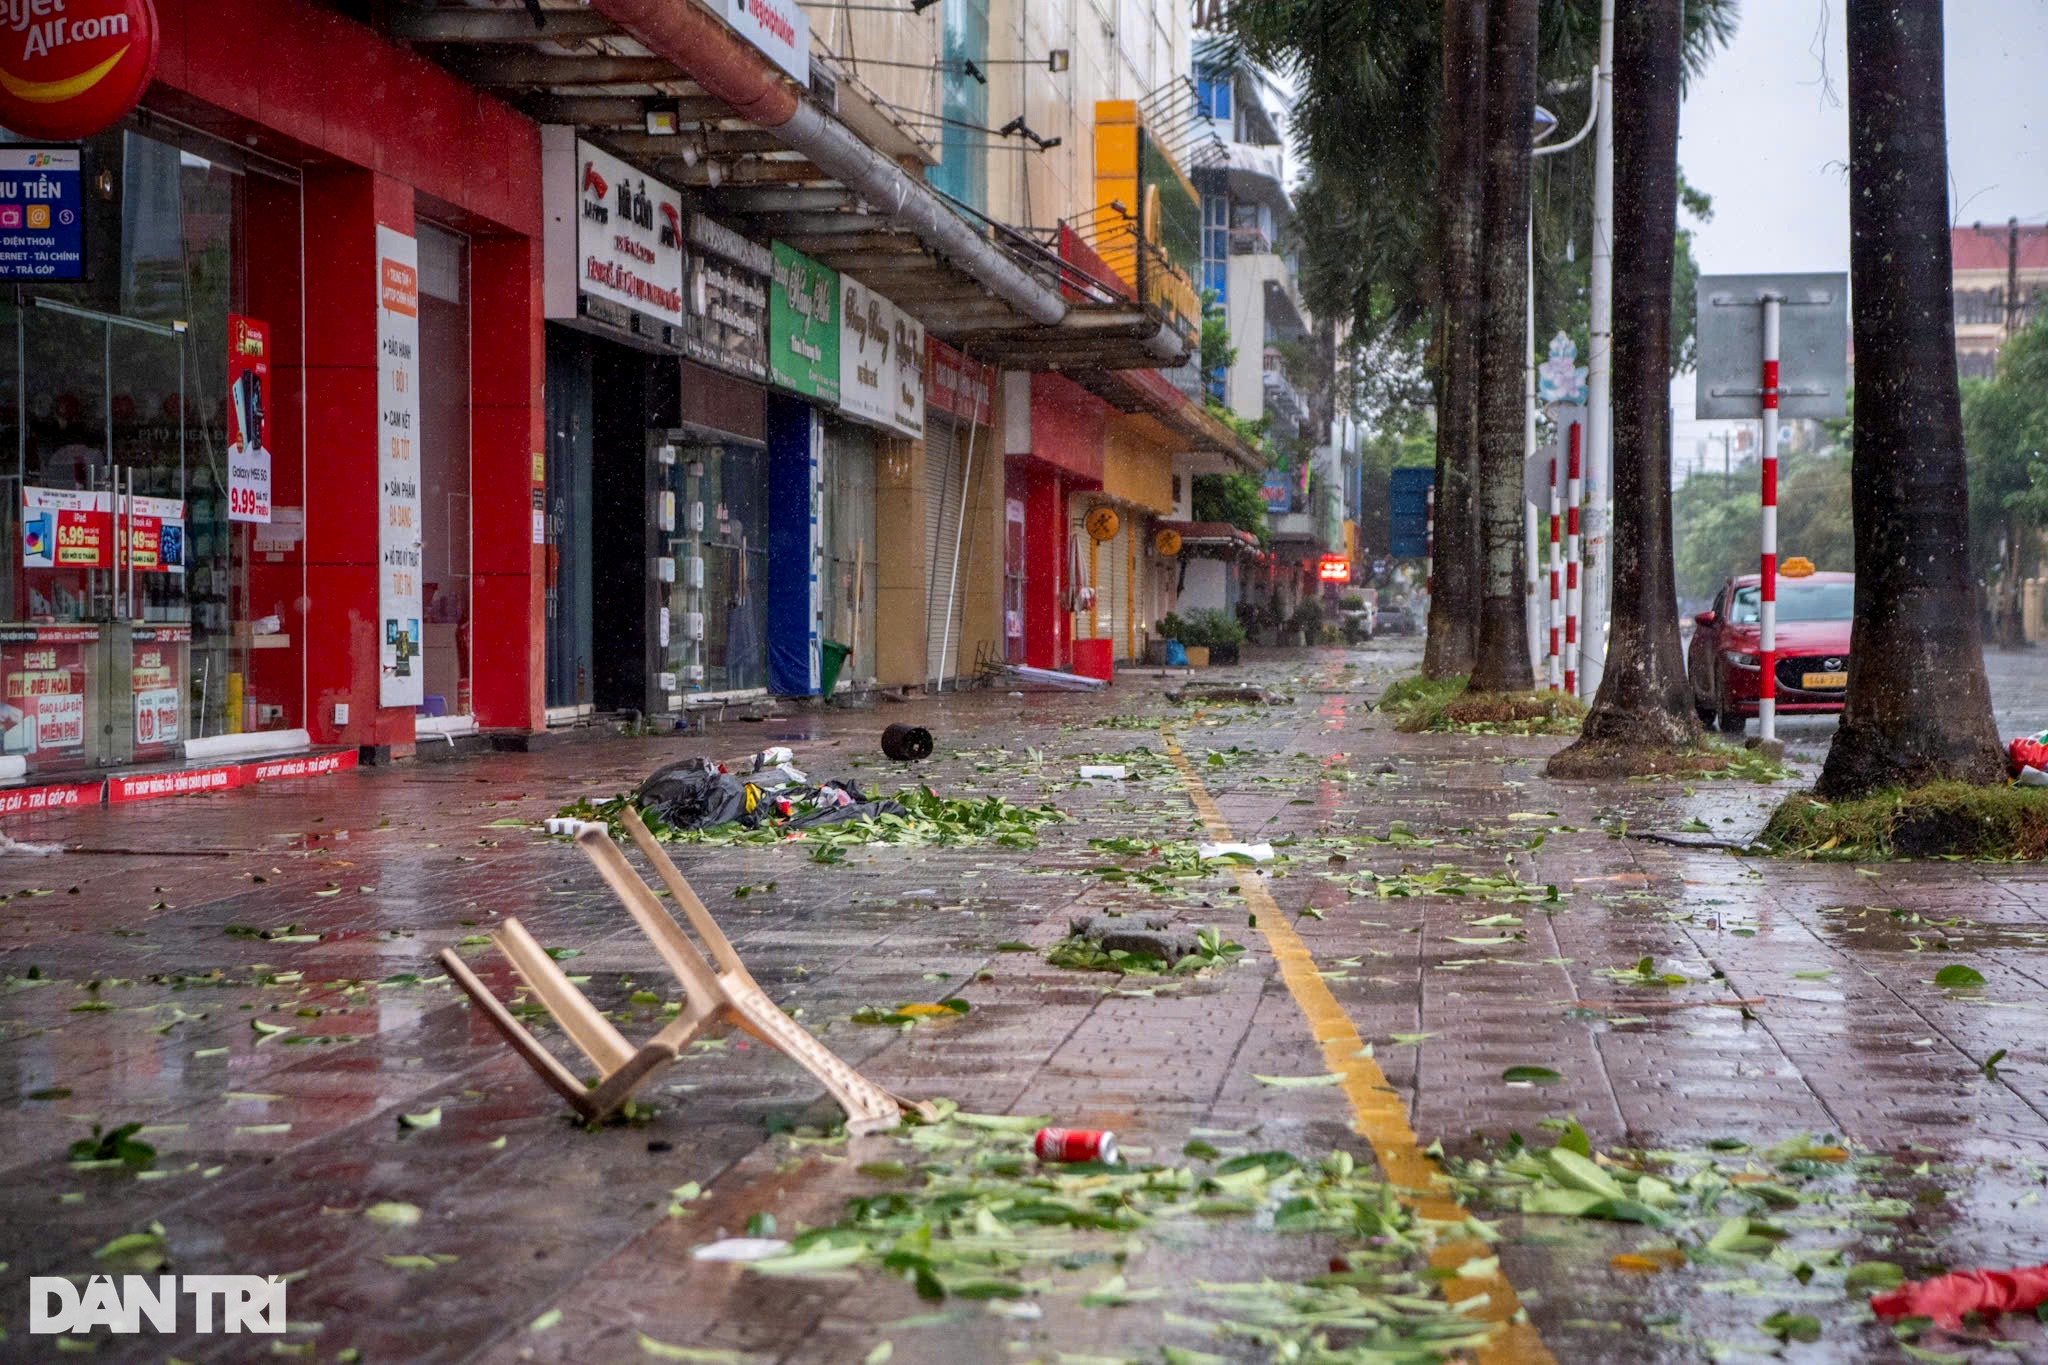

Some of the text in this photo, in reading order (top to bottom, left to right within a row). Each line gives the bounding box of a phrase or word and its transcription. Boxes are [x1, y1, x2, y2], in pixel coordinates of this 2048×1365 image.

[23, 13, 129, 61] Air.com
[22, 173, 61, 199] TIỀN
[3, 236, 55, 247] ĐIỆN THOẠI
[34, 251, 48, 261] TÀI
[50, 250, 80, 261] CHÍNH
[16, 264, 33, 274] TRẢ
[34, 264, 55, 274] GÓP
[399, 340, 412, 360] HÀNH
[390, 407, 410, 429] CAM KẾT
[232, 464, 250, 482] Galaxy
[390, 475, 416, 499] SẢN PHẨM
[231, 488, 256, 514] 9.99
[256, 504, 268, 518] TRIỆU
[73, 512, 86, 522] iPad
[58, 525, 84, 546] 6.99
[85, 536, 99, 546] TRIỆU
[40, 648, 56, 669] RẺ
[40, 703, 52, 714] GIAO
[59, 698, 70, 713] LẮP
[40, 714, 80, 738] MIỄN PHÍ
[256, 766, 267, 778] FPT
[268, 764, 282, 778] SHOP
[297, 758, 305, 774] CÁI
[309, 756, 319, 772] TRẢ
[319, 756, 330, 772] GÓP
[331, 758, 339, 768] 0%
[124, 781, 136, 796] FPT
[136, 780, 149, 794] SHOP
[7, 792, 22, 811] CÁI
[29, 788, 46, 808] TRẢ
[48, 786, 64, 806] GÓP
[65, 789, 78, 803] 0%
